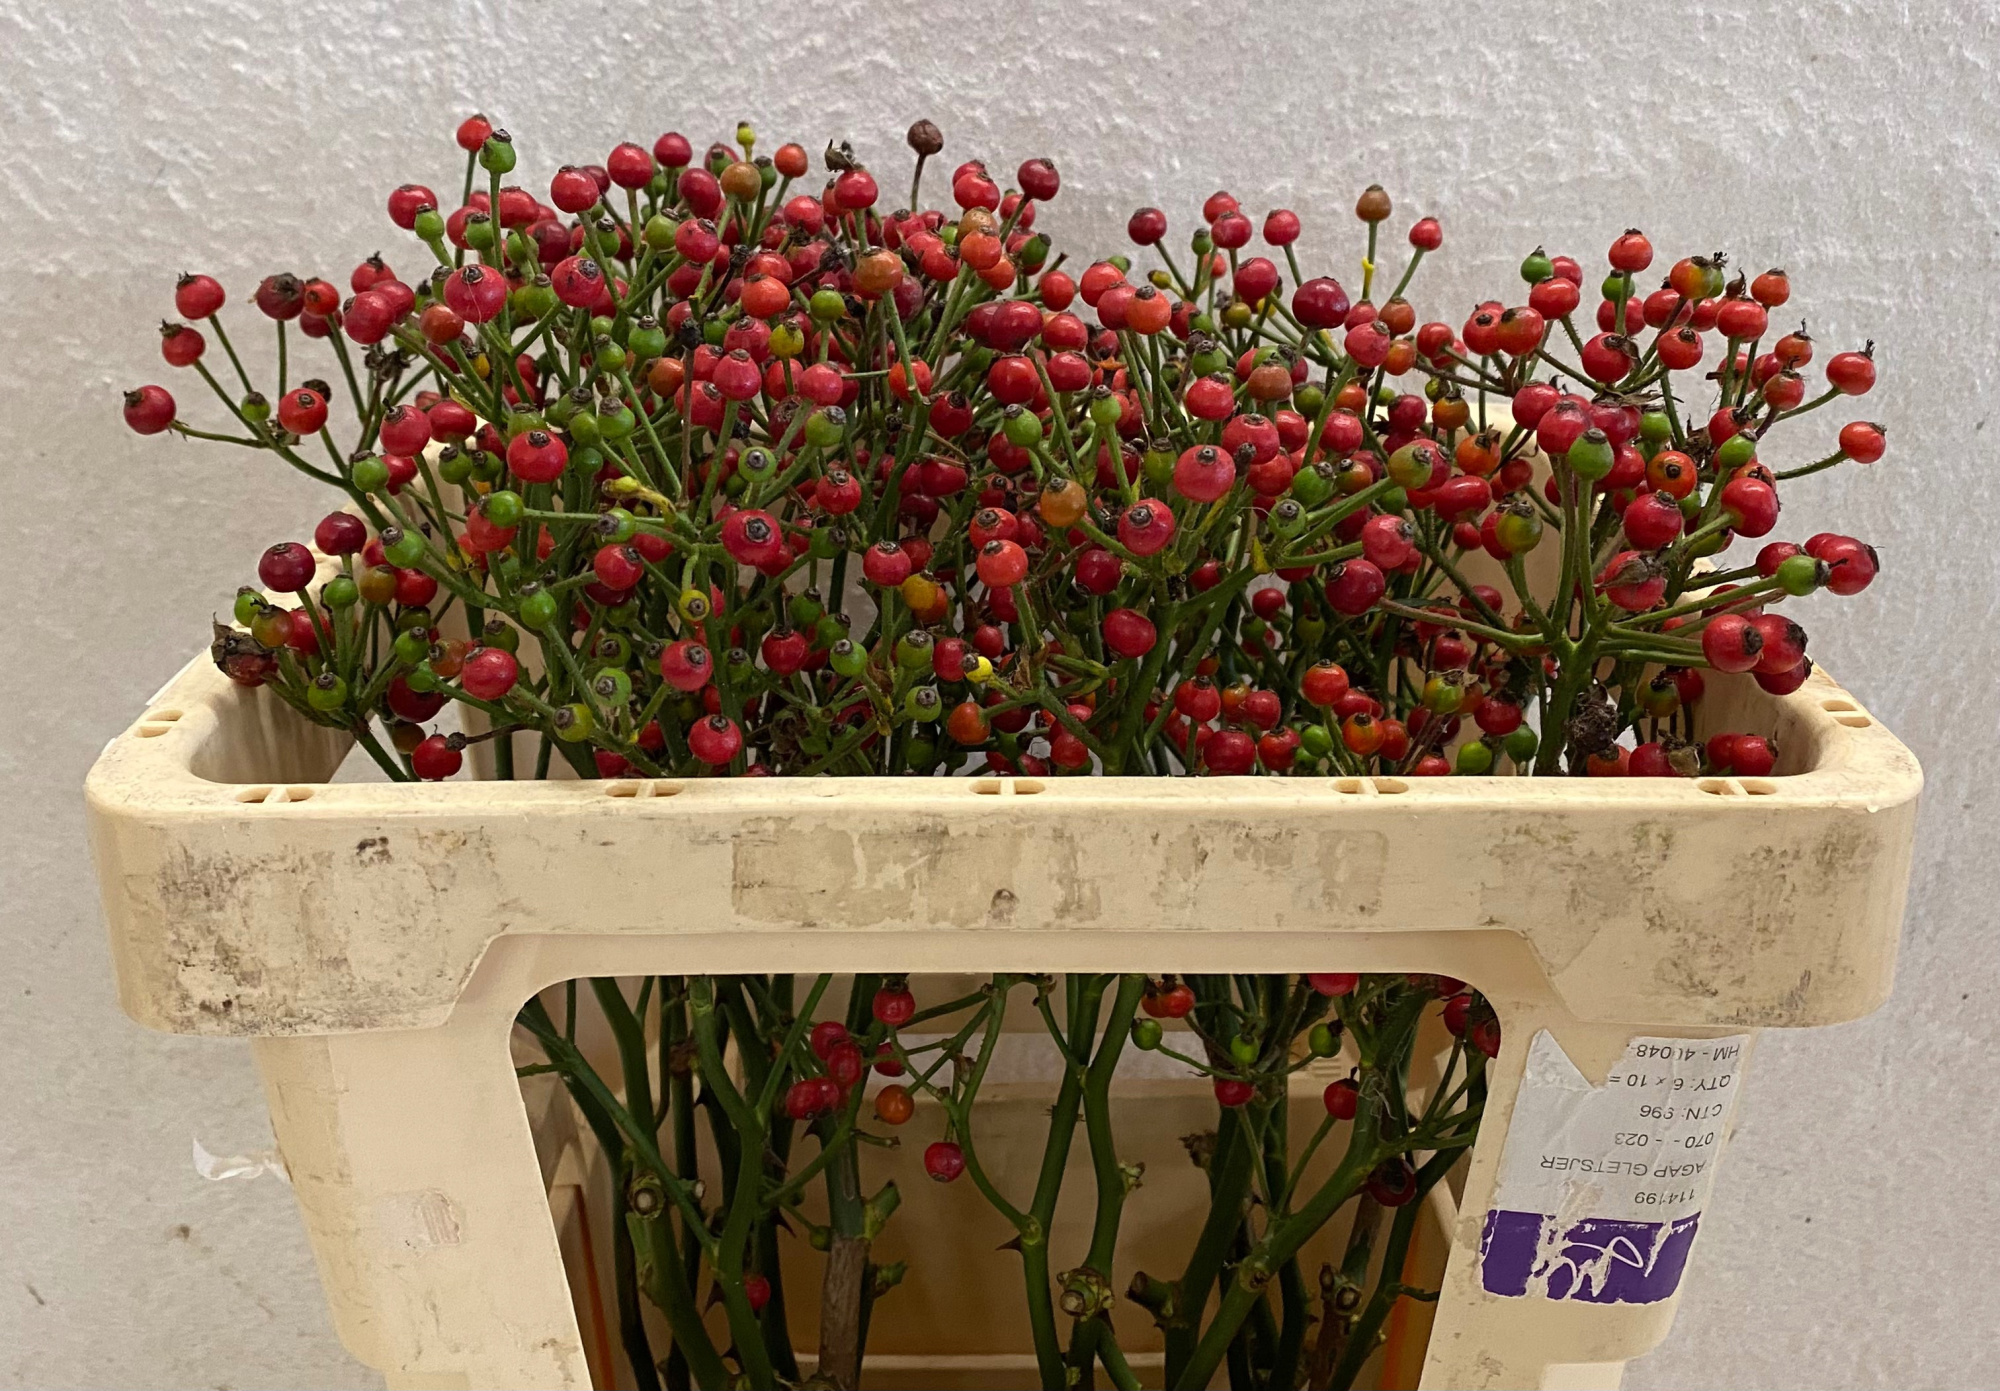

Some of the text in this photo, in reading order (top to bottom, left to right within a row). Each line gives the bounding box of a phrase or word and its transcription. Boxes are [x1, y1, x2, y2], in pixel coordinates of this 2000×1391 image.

[1712, 1043, 1740, 1060] HM
[1627, 1073, 1648, 1088] 10
[1673, 1077, 1684, 1091] 6
[1688, 1074, 1731, 1091] QTY:
[1681, 1103, 1723, 1120] CTN:
[1614, 1132, 1649, 1147] 023
[1685, 1131, 1714, 1148] 070
[1540, 1155, 1707, 1177] AGAP GLETSJER
